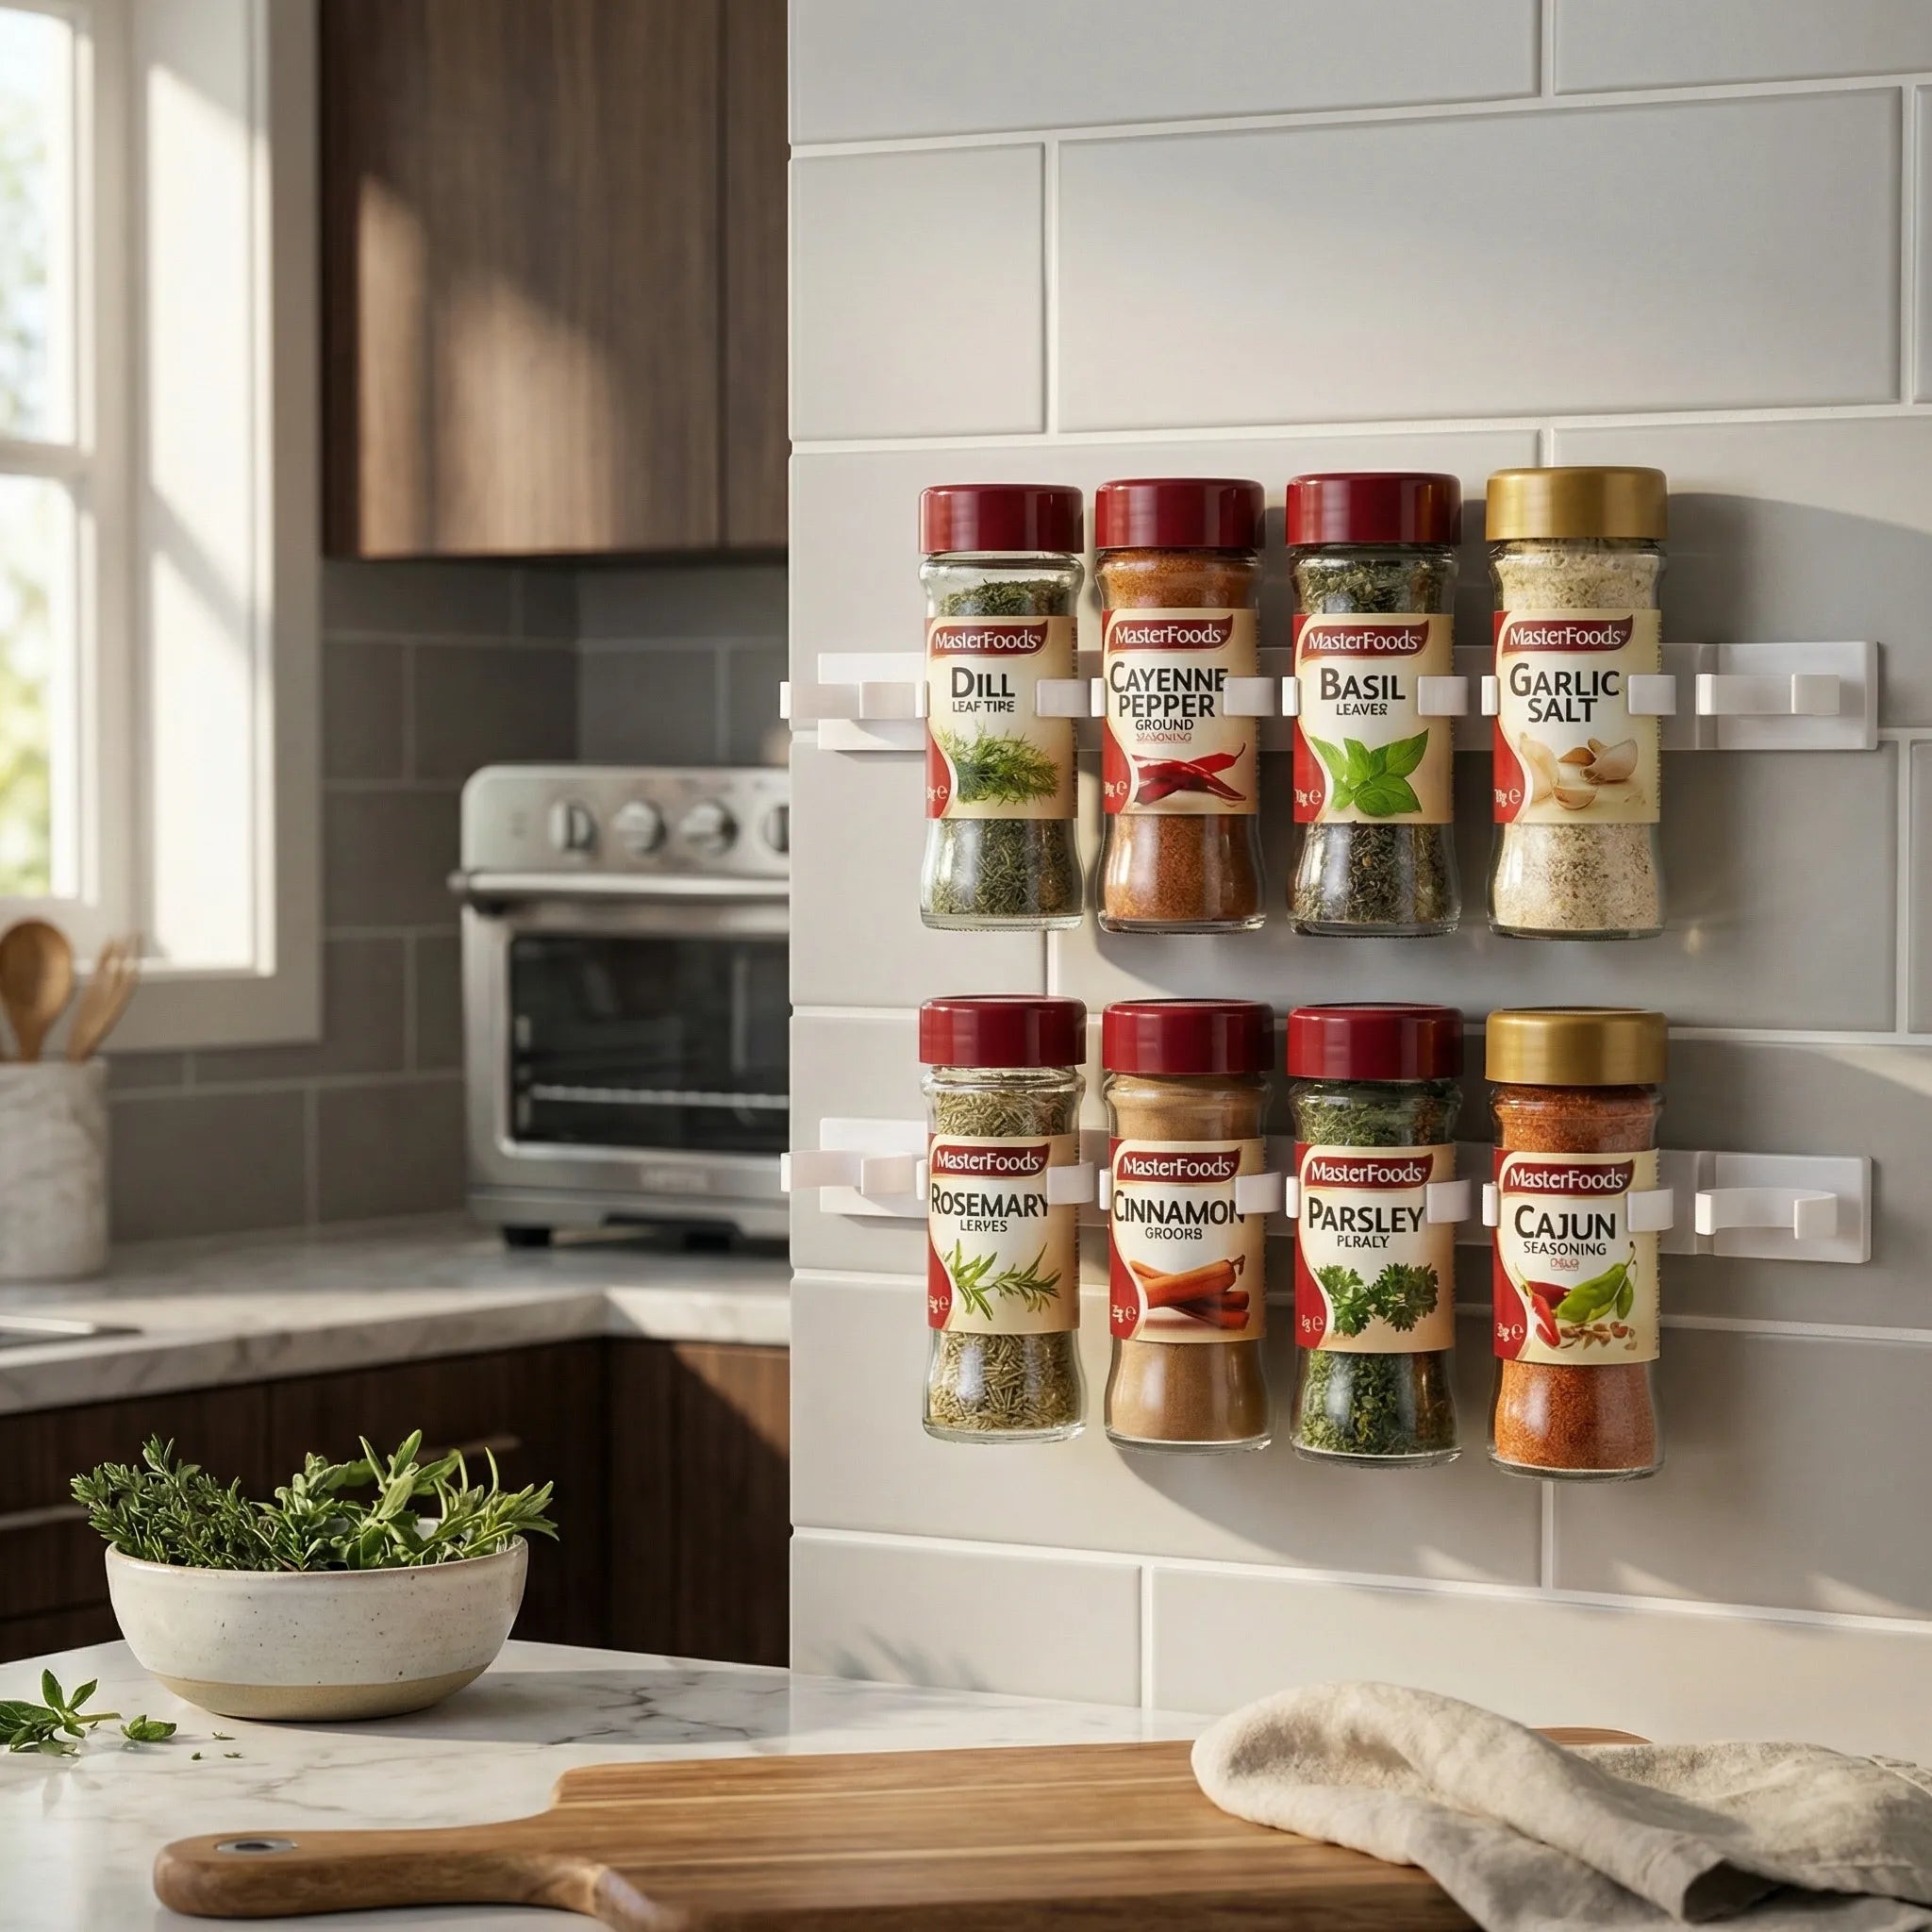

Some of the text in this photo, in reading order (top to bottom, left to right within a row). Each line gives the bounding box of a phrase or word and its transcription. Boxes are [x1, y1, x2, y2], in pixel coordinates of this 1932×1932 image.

[951, 666, 1016, 698] DILL
[1110, 661, 1229, 693] CAYENNE
[1321, 668, 1406, 700] BASIL
[1510, 662, 1620, 696] GARLIC
[953, 701, 982, 712] LEAF
[1119, 694, 1215, 717] PEPPER
[1528, 698, 1598, 723] SALT
[1135, 719, 1194, 730] GROUND
[931, 1183, 1049, 1218] ROSEMARY
[1308, 1196, 1424, 1233] PARSLEY
[1514, 1205, 1616, 1240] CAJUN
[1524, 1241, 1607, 1256] SEASONING
